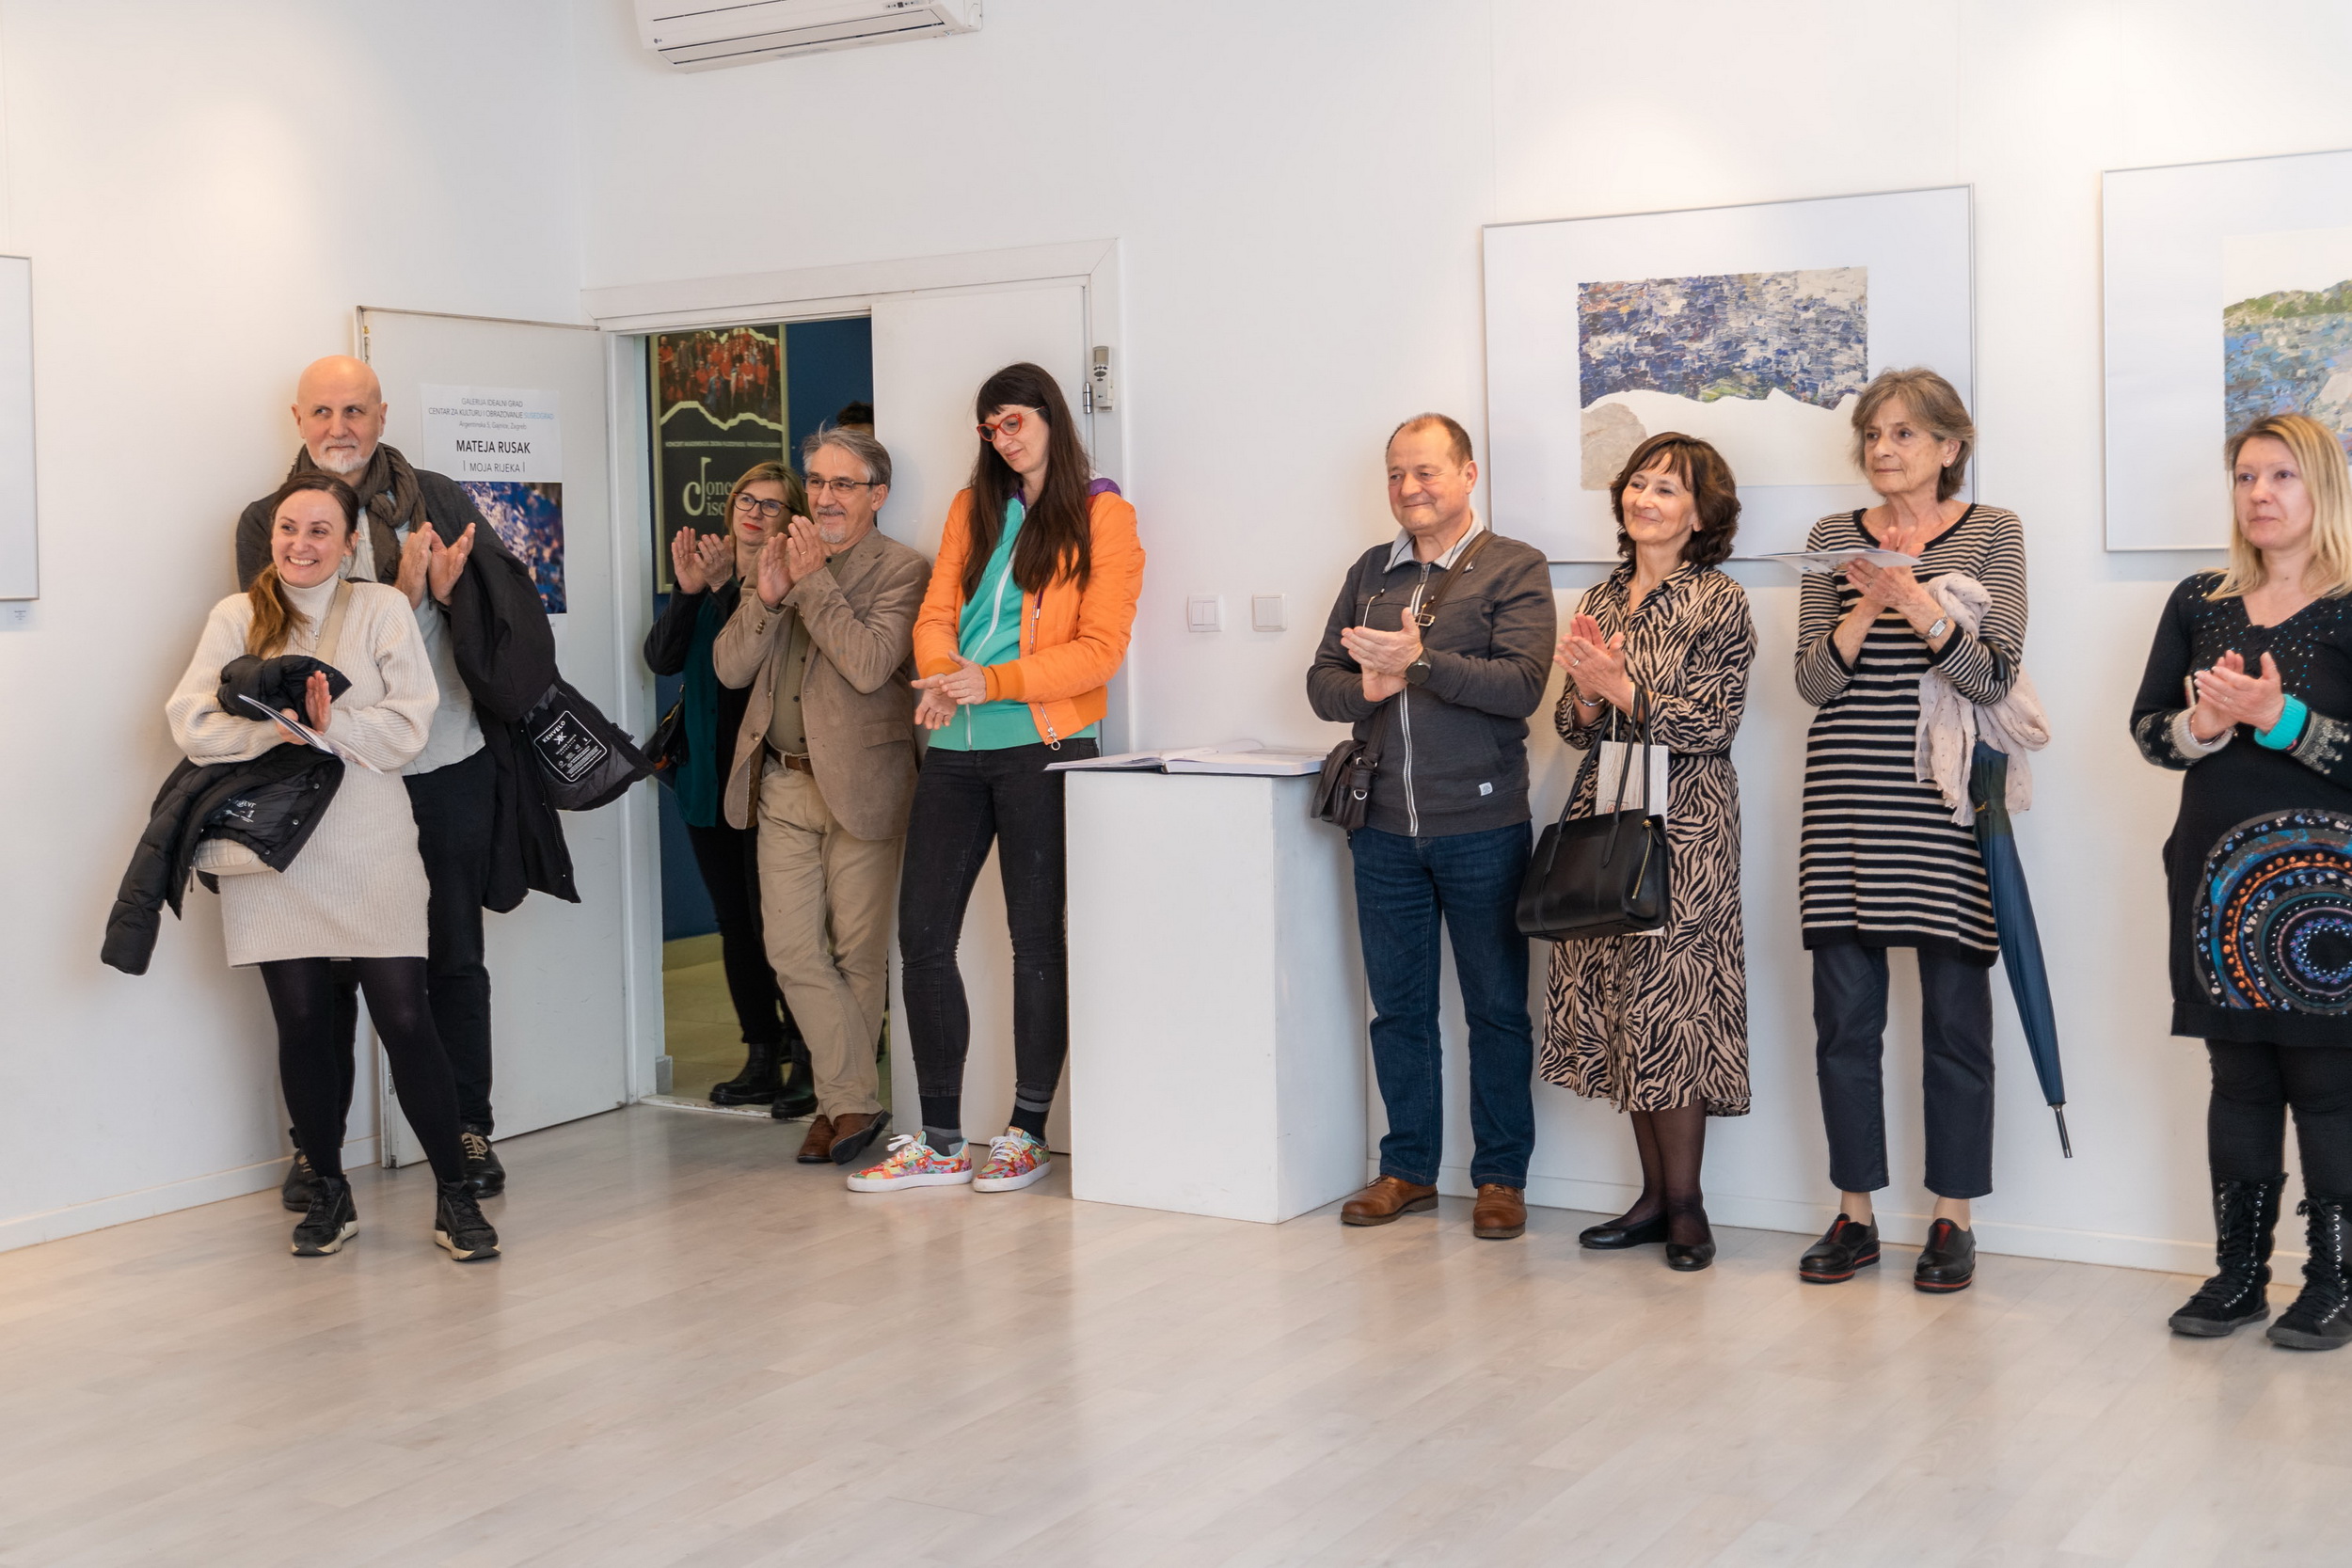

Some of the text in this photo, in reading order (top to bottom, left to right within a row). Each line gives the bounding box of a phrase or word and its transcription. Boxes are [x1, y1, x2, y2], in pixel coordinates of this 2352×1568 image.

[485, 410, 523, 419] OBRAZOVANJE
[456, 439, 531, 453] MATEJA RUSAK
[469, 462, 492, 472] MOJA
[494, 463, 520, 472] RIJEKA
[542, 721, 565, 743] KENVELO
